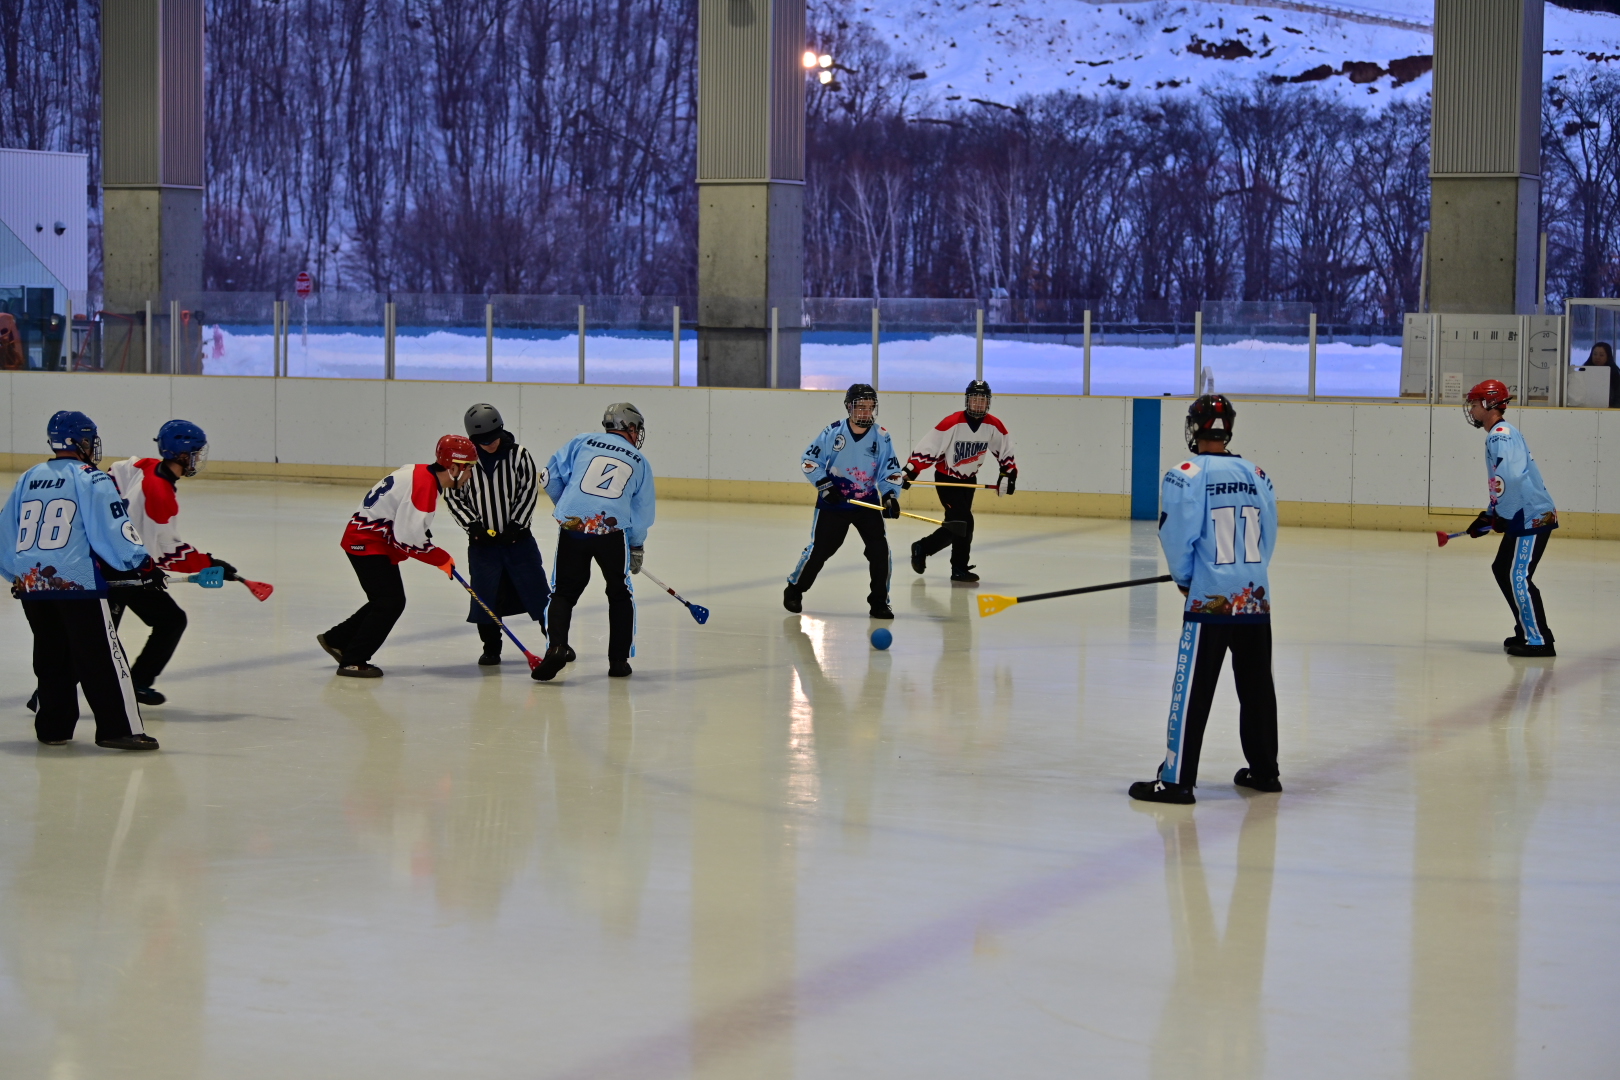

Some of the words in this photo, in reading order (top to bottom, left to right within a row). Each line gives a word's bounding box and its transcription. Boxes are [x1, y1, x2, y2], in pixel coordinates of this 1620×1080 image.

[586, 438, 642, 464] HOOPER
[805, 444, 822, 459] 24
[886, 457, 901, 471] 24
[953, 440, 989, 465] SAROMA
[29, 478, 66, 491] WILD
[15, 497, 78, 555] 88
[1210, 504, 1262, 565] 11
[1519, 538, 1530, 561] NSW
[1180, 621, 1194, 651] NSW
[108, 619, 130, 680] ACACIA
[1167, 653, 1188, 741] BROOMBALL
